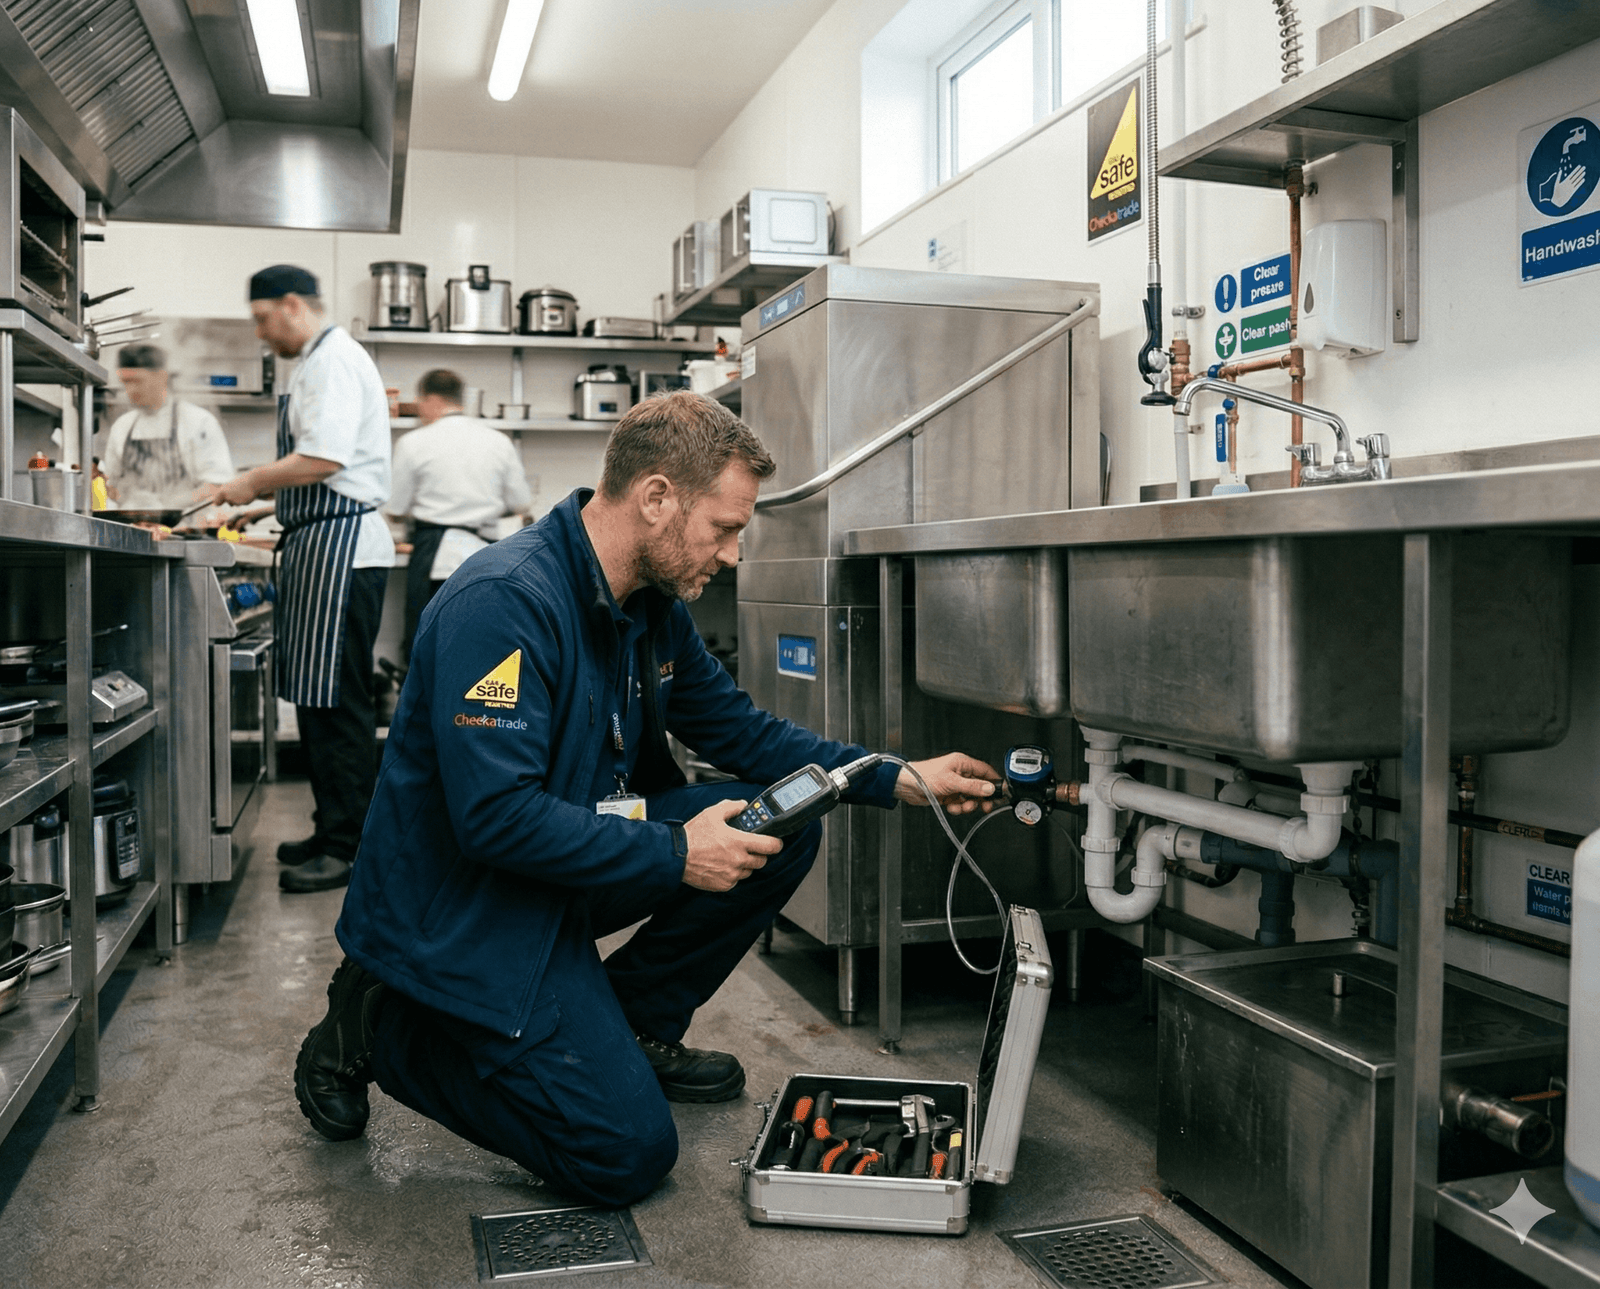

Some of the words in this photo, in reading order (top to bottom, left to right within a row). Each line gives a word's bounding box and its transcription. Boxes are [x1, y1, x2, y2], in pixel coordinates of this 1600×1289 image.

[1100, 154, 1134, 189] safe
[1242, 326, 1267, 341] Clear
[476, 683, 515, 699] safe
[1529, 864, 1570, 885] CLEAR
